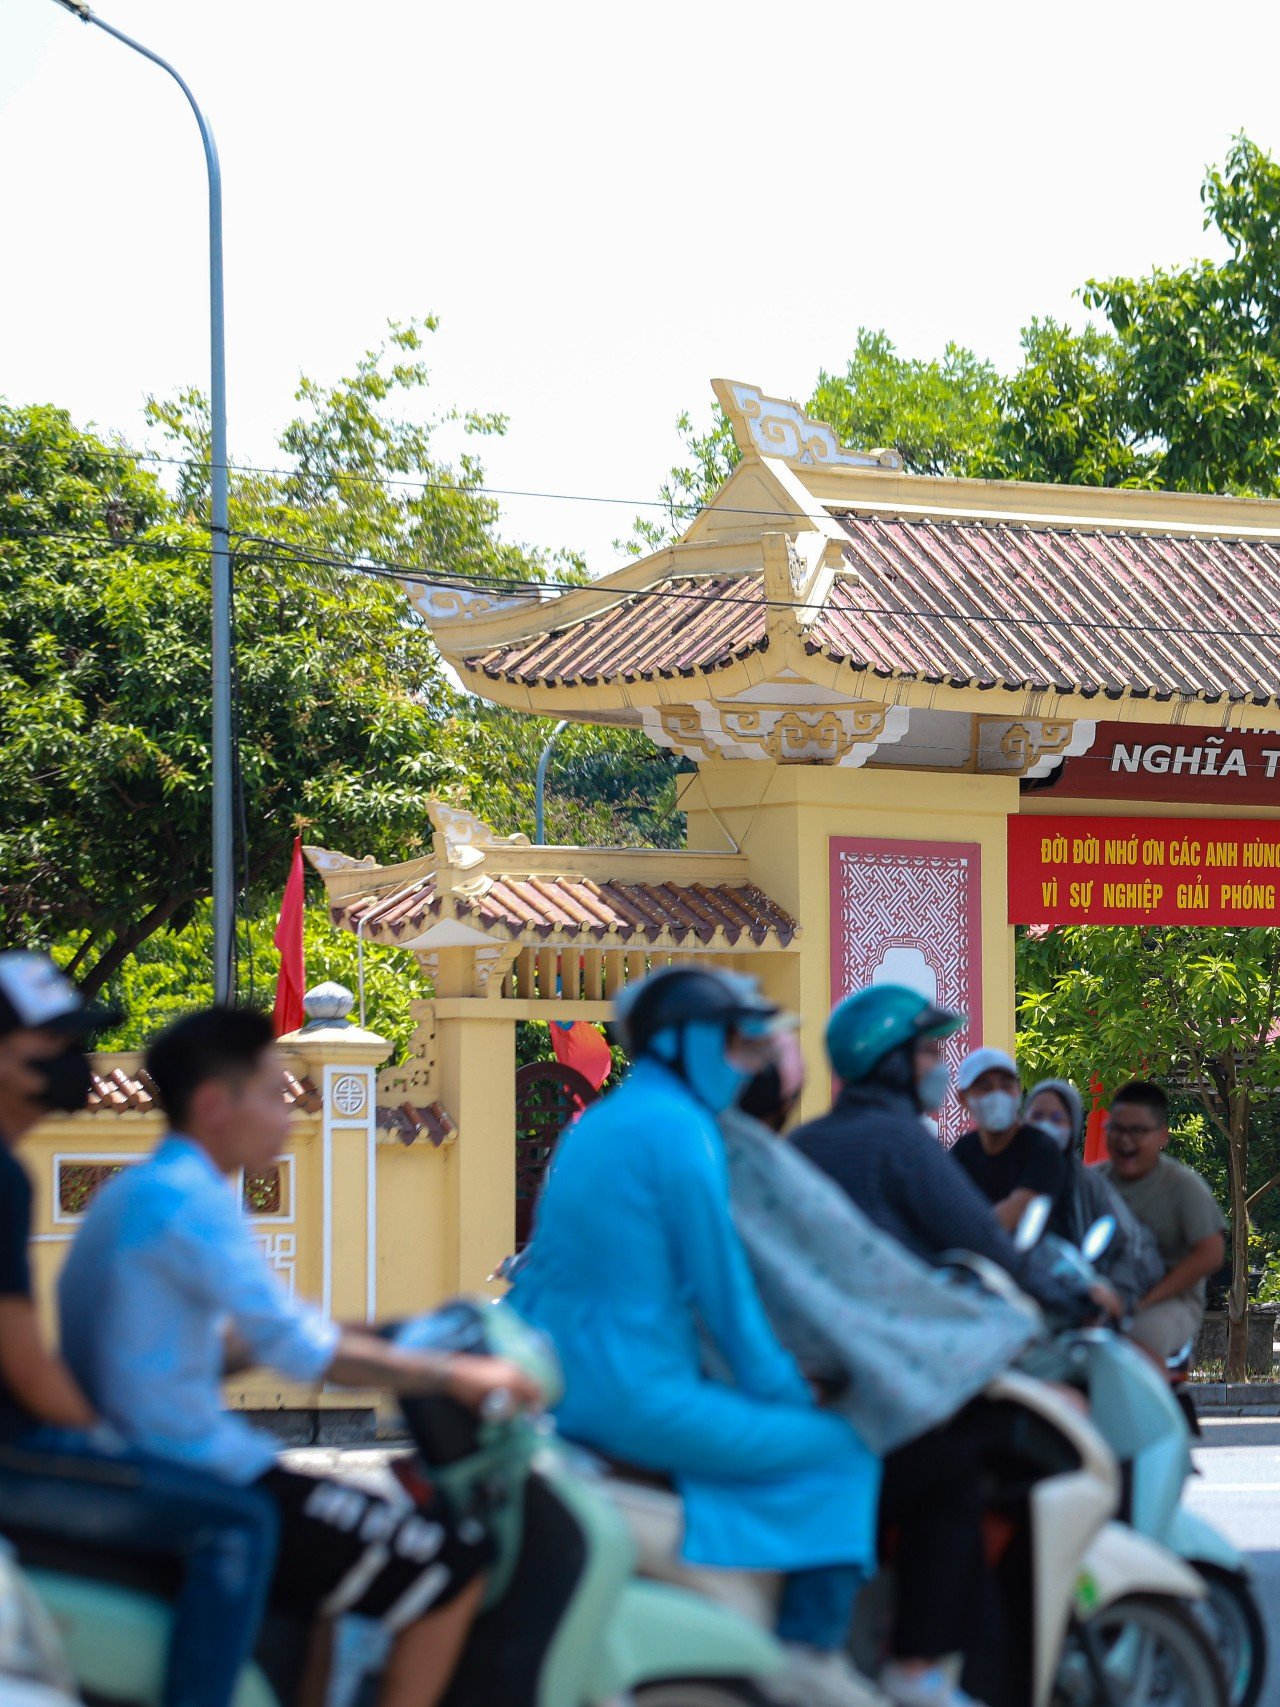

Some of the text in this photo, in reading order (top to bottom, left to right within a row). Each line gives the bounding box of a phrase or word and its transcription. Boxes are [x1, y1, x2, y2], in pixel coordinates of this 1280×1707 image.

[1110, 736, 1248, 776] NGHĨA
[1041, 832, 1067, 864] ĐỜI
[1073, 832, 1099, 864] ĐỜI
[1105, 834, 1138, 865] NHỚ
[1143, 838, 1165, 866] ƠN
[1169, 835, 1200, 866] CÁC
[1205, 842, 1238, 867] ANH
[1041, 876, 1057, 908] VÌ
[1069, 880, 1093, 913] SỰ
[1103, 878, 1163, 913] NGHIỆP
[1176, 874, 1209, 909] GIẢI
[1220, 879, 1275, 909] PHÓNG
